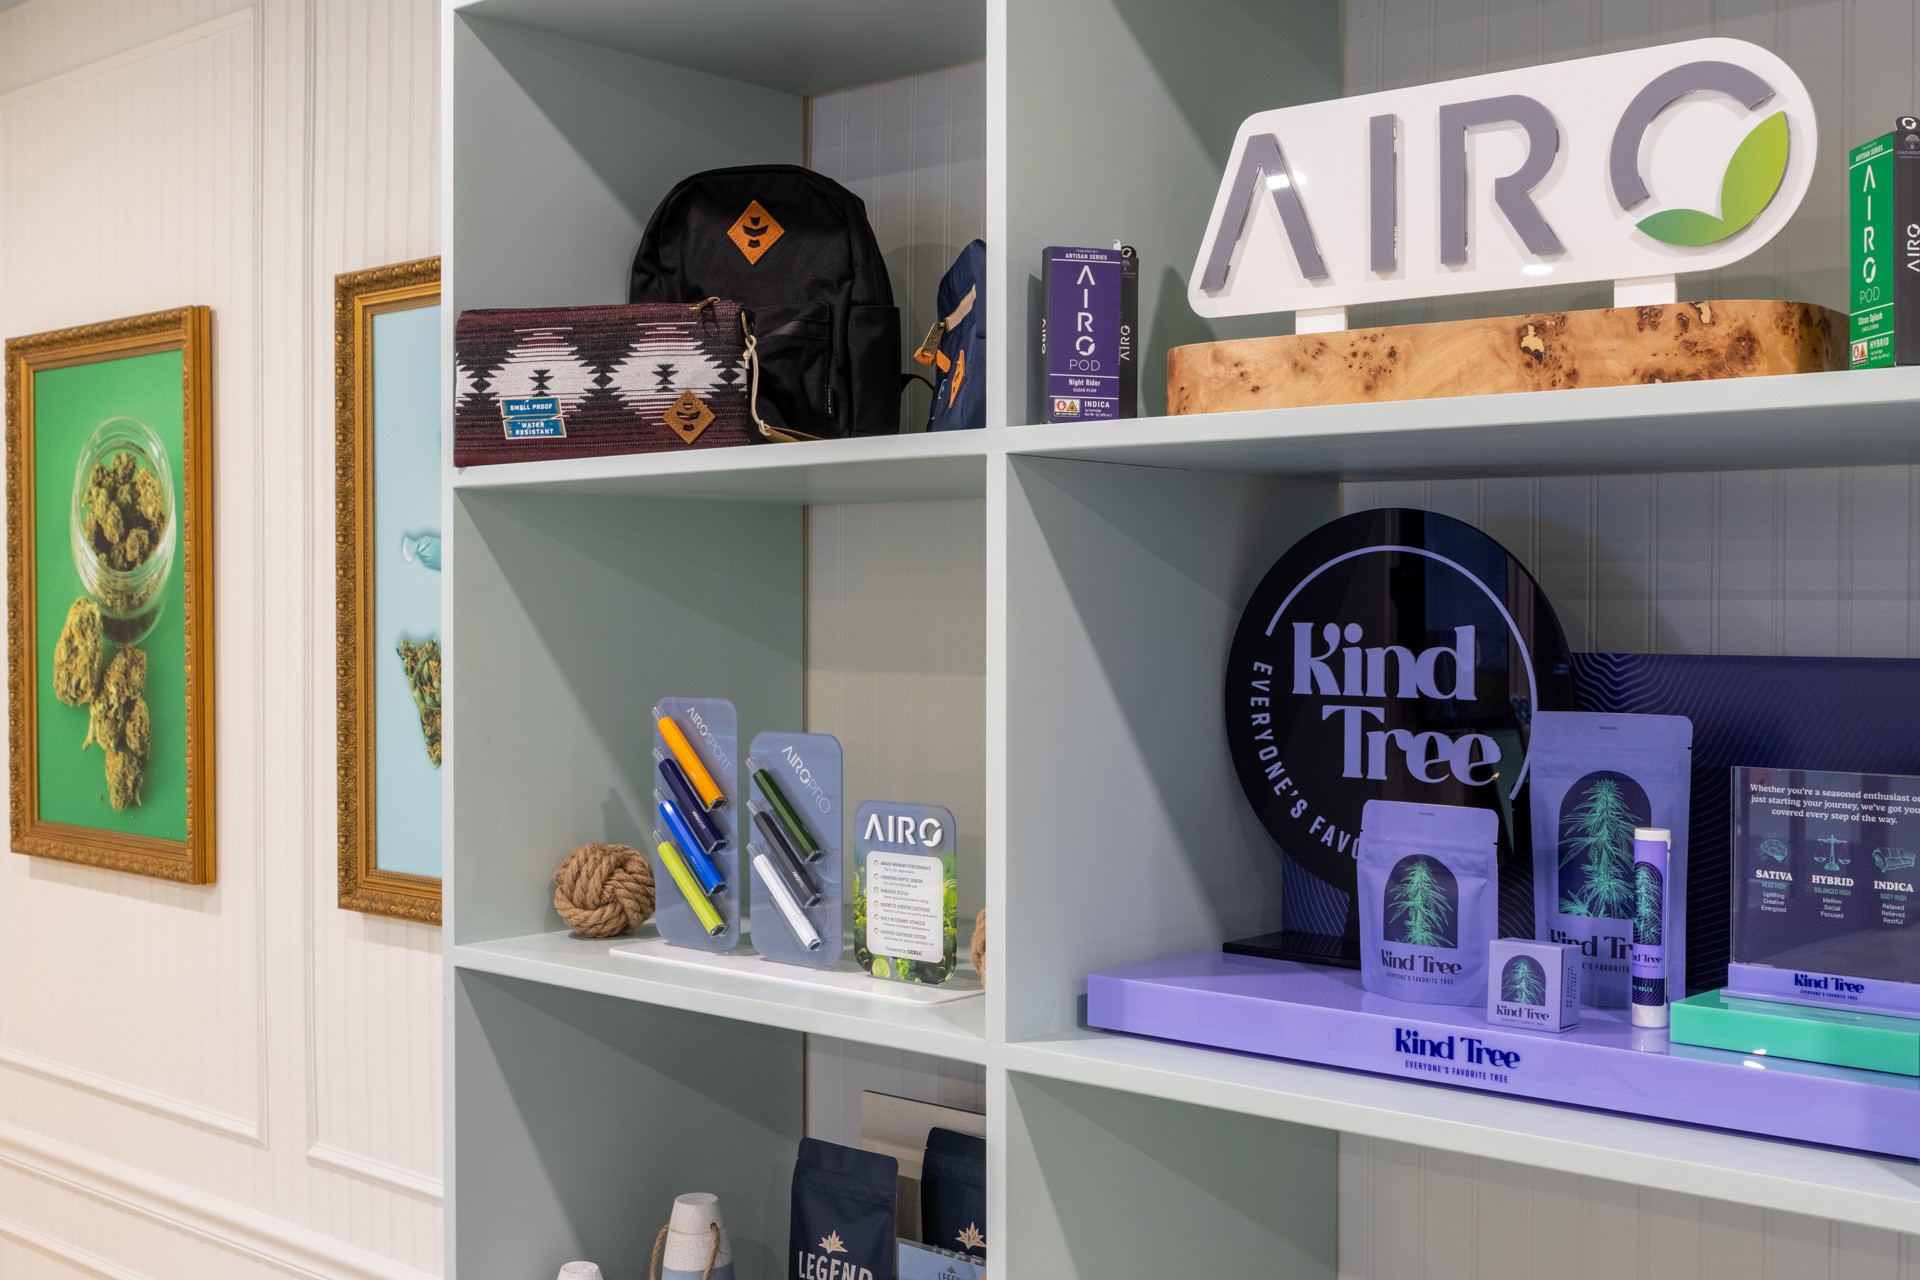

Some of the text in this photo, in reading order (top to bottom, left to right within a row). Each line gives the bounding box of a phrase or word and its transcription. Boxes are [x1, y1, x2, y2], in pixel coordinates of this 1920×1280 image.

[1199, 61, 1791, 291] AIRO
[1860, 286, 1881, 304] POD
[1075, 265, 1096, 356] AIRO
[1120, 325, 1131, 361] AIRO
[1870, 337, 1889, 349] HYBRID
[1069, 359, 1101, 371] POD
[1068, 378, 1084, 387] Night
[1292, 622, 1477, 701] Kind
[1322, 704, 1503, 787] Tree
[1750, 783, 1786, 793] Whether
[1786, 787, 1813, 795] you're
[1822, 790, 1862, 799] seasoned
[1863, 792, 1910, 802] enthusiast
[1751, 795, 1767, 804] just
[1768, 797, 1801, 807] starting
[1824, 800, 1859, 811] journey,
[1860, 803, 1886, 811] we've
[1887, 806, 1902, 814] got
[1771, 808, 1804, 817] covered
[1805, 811, 1829, 820] every
[1831, 812, 1849, 822] step
[1861, 814, 1877, 822] the
[1878, 817, 1898, 825] way.
[863, 813, 943, 848] AIRO
[1756, 869, 1793, 881] SATIVA
[1811, 875, 1854, 887] HYBRID
[1814, 886, 1838, 895] BALANCED
[1873, 880, 1914, 892] INDICA
[1762, 891, 1785, 900] Uplifting
[1894, 894, 1907, 902] HIGH
[1763, 898, 1785, 906] Creative
[1882, 903, 1905, 911] Relaxed
[1820, 911, 1844, 919] Focused
[1881, 910, 1905, 918] Relieved
[1883, 917, 1904, 925] Restful
[1381, 949, 1463, 976] Kind Tree
[1642, 954, 1663, 963] Tree
[1595, 964, 1631, 973] FAVORITE
[1412, 976, 1438, 984] FAVORITE
[1794, 973, 1865, 994] Kind Tree
[1496, 1004, 1550, 1021] Kind Tree
[1395, 1028, 1521, 1070] Kind Tree
[1405, 1060, 1508, 1083] EVERYONE'S FAVORITE TREE
